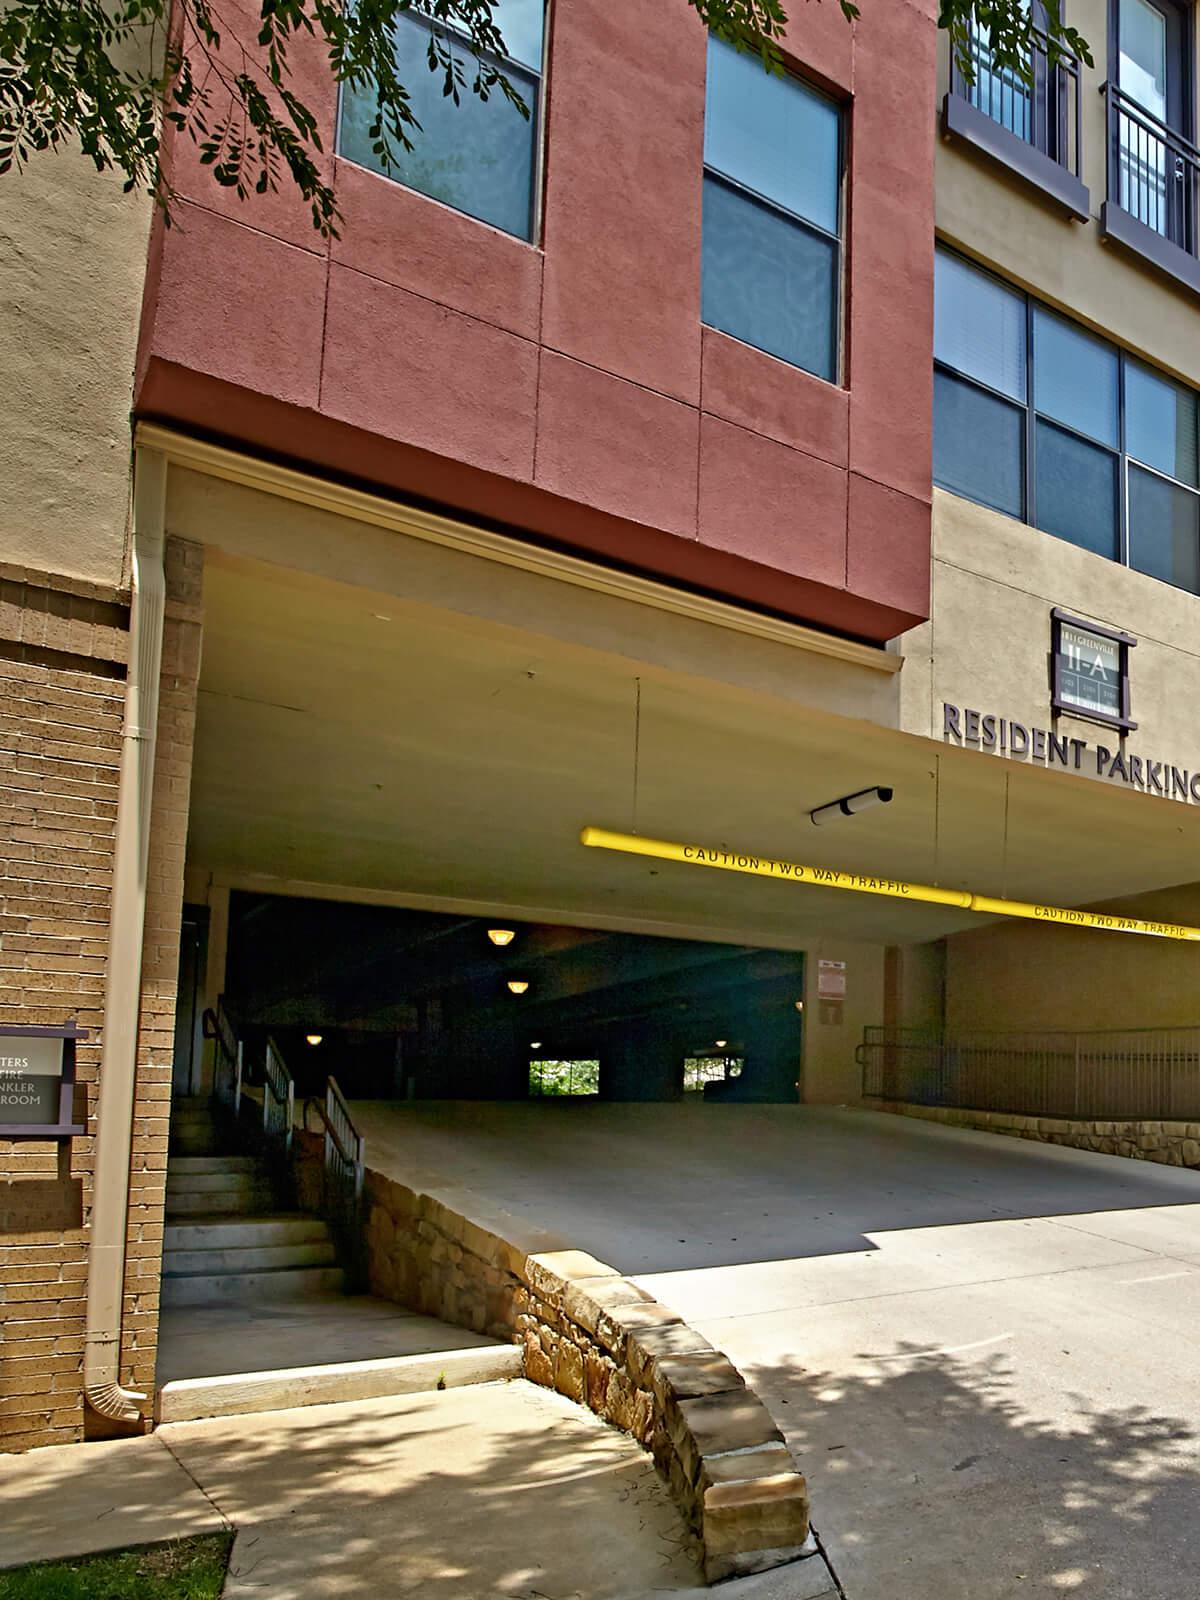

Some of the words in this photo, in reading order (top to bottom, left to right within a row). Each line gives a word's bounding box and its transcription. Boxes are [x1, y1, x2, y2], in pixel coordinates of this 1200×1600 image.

[1077, 635, 1114, 657] GREENVILLE
[943, 702, 1087, 769] RESIDENT
[683, 846, 759, 870] CAUTION
[767, 861, 804, 877] TWO
[813, 868, 841, 882] WAY
[849, 874, 909, 894] TRAFFIC
[1034, 906, 1084, 922] CAUTION
[1089, 914, 1113, 927] TWO
[1117, 918, 1139, 929] WAY
[1143, 922, 1185, 937] TRAFFIC
[0, 1095, 41, 1105] ROOM
